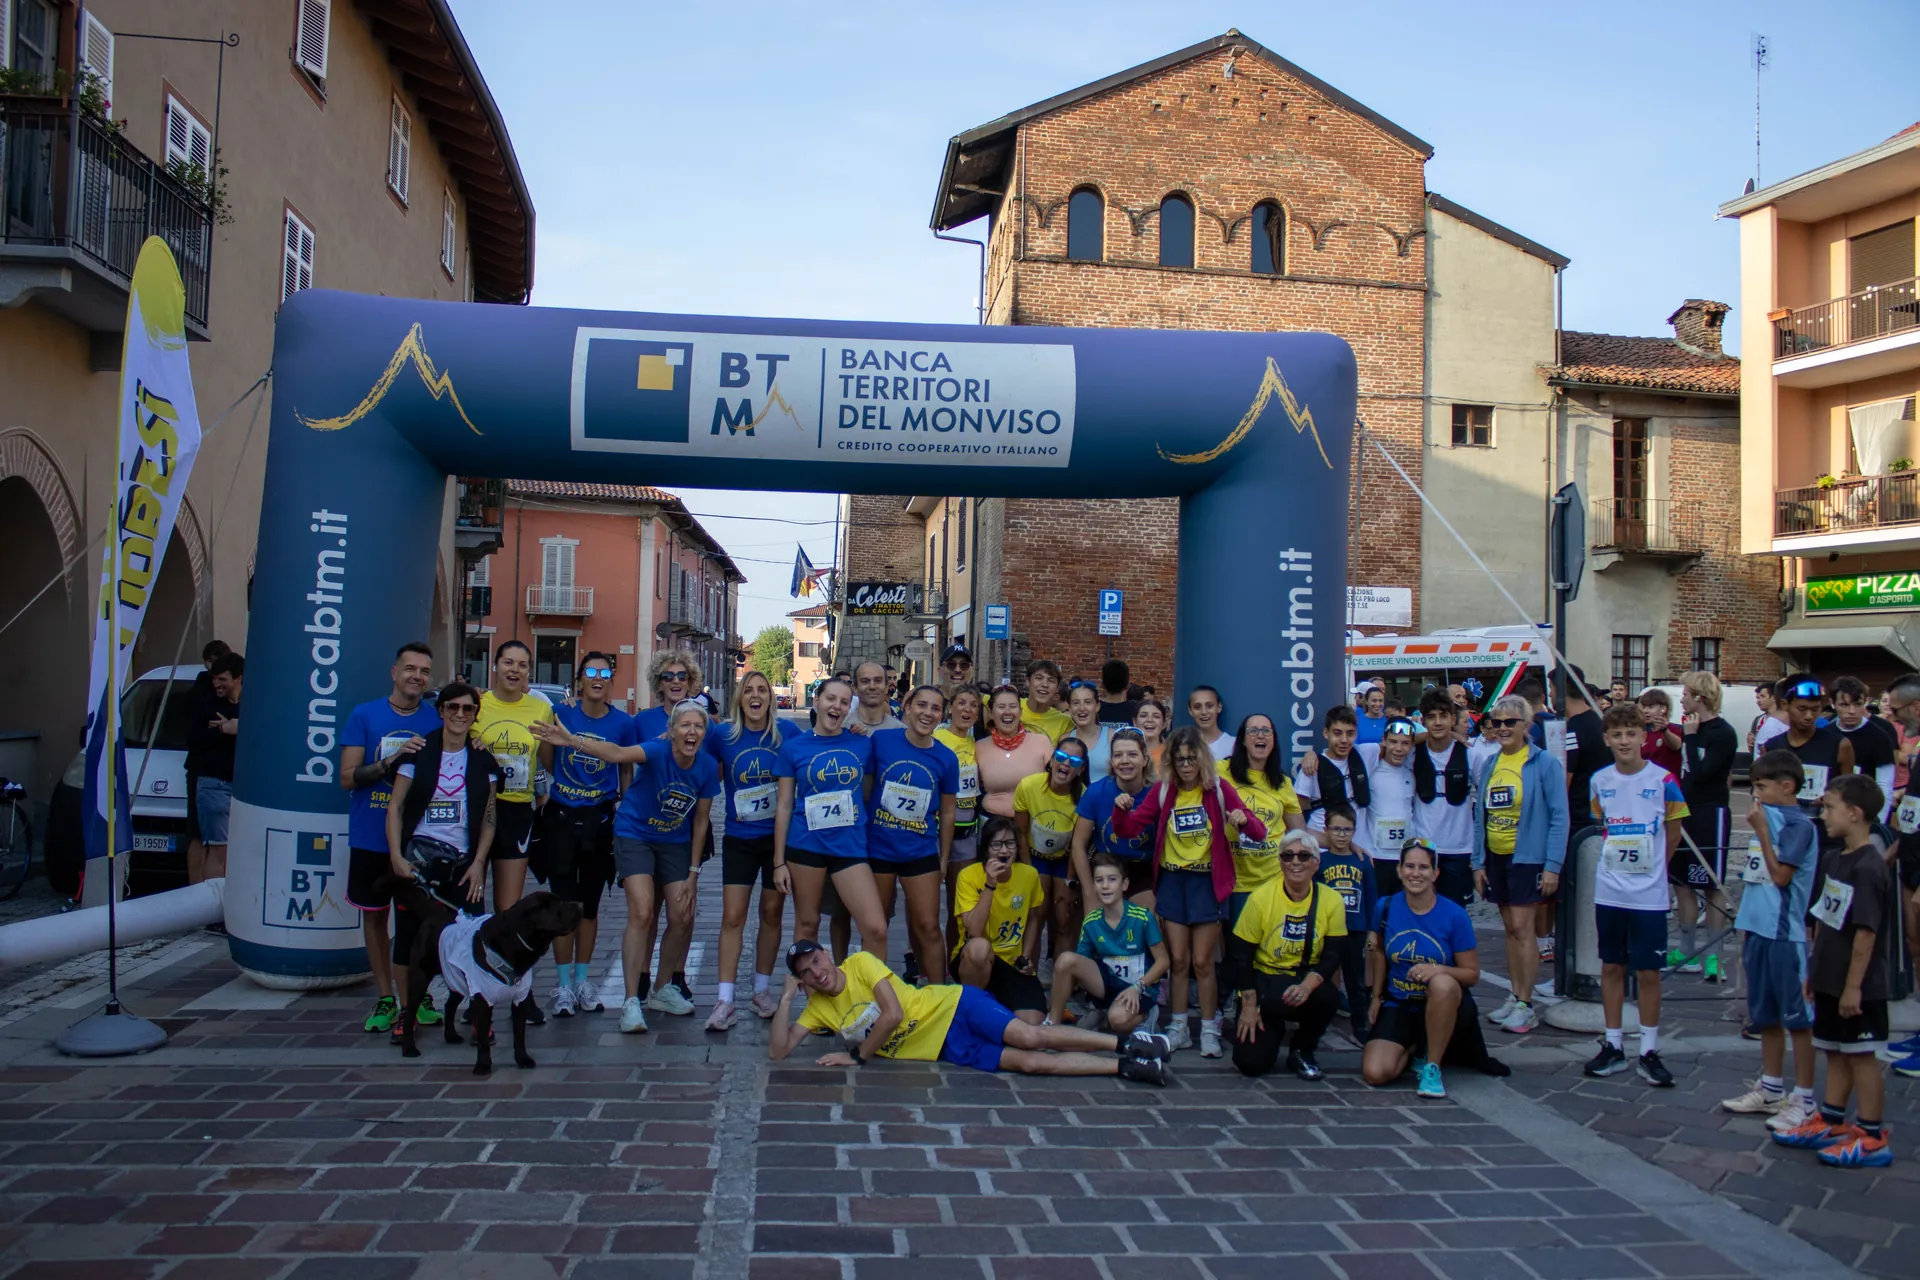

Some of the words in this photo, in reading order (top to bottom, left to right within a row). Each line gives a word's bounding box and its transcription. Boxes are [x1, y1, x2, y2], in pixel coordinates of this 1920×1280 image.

[841, 348, 953, 373] BANCA
[719, 352, 790, 397] BT
[838, 374, 991, 403] TERRITORI
[710, 397, 756, 436] M
[838, 404, 892, 431] DEL
[900, 406, 1061, 435] MONVISO
[837, 441, 893, 451] CREDITO
[897, 442, 992, 455] COOPERATIVO
[996, 445, 1059, 456] ITALIANO
[1856, 572, 1920, 594] PIZZA
[1104, 592, 1118, 610] P
[296, 509, 348, 783] bancabtm.it
[1279, 548, 1315, 780] ancabtm.it
[1366, 656, 1393, 665] VERDE
[1395, 656, 1427, 665] VINOVO
[1429, 655, 1471, 665] CANDIOLO
[1473, 654, 1505, 664] PIOBESI
[371, 791, 393, 802] STRA
[665, 798, 686, 809] 453
[751, 796, 770, 812] 73
[896, 796, 916, 812] 72
[1492, 792, 1508, 803] 331
[430, 808, 455, 819] 353
[821, 803, 842, 818] 74
[1178, 814, 1203, 827] 332
[1388, 829, 1405, 840] 53
[1045, 839, 1055, 848] 6
[1618, 849, 1639, 863] 75
[291, 869, 335, 898] BT
[1342, 895, 1356, 906] 45
[1824, 893, 1841, 914] 07
[286, 897, 314, 922] M
[1114, 964, 1129, 978] 21
